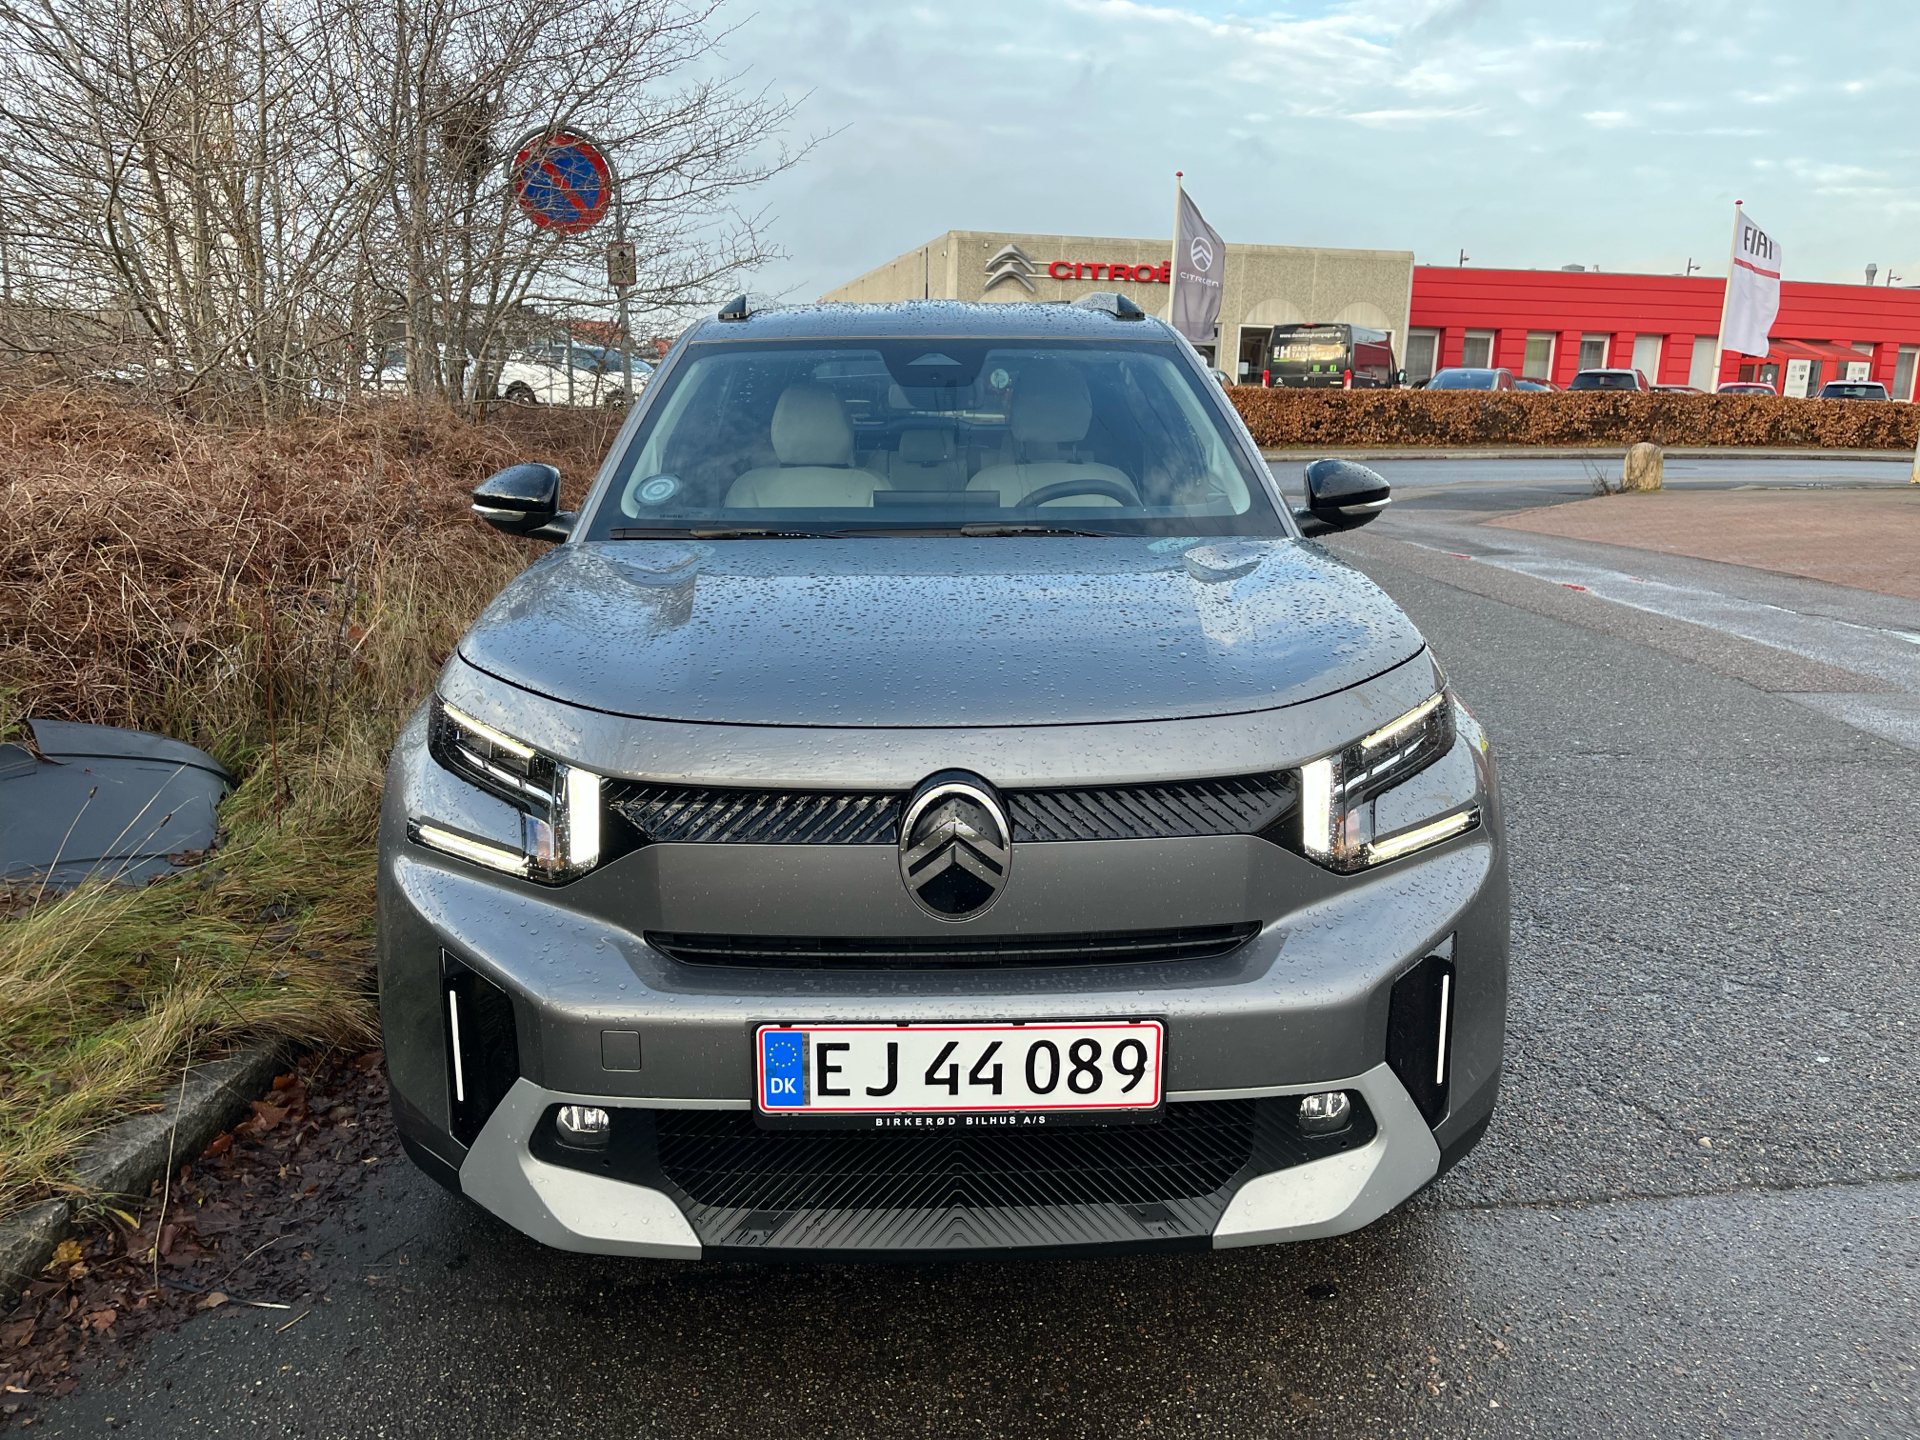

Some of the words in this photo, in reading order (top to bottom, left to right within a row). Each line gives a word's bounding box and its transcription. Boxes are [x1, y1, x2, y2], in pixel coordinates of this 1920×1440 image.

[1048, 260, 1171, 283] CITROË
[815, 1041, 899, 1097] EJ
[924, 1040, 1004, 1096] 44
[1024, 1038, 1148, 1095] 089
[770, 1077, 797, 1095] DK
[875, 1116, 956, 1126] BIRKERØD
[966, 1116, 1016, 1125] BILHUS
[1023, 1115, 1046, 1124] A/S
